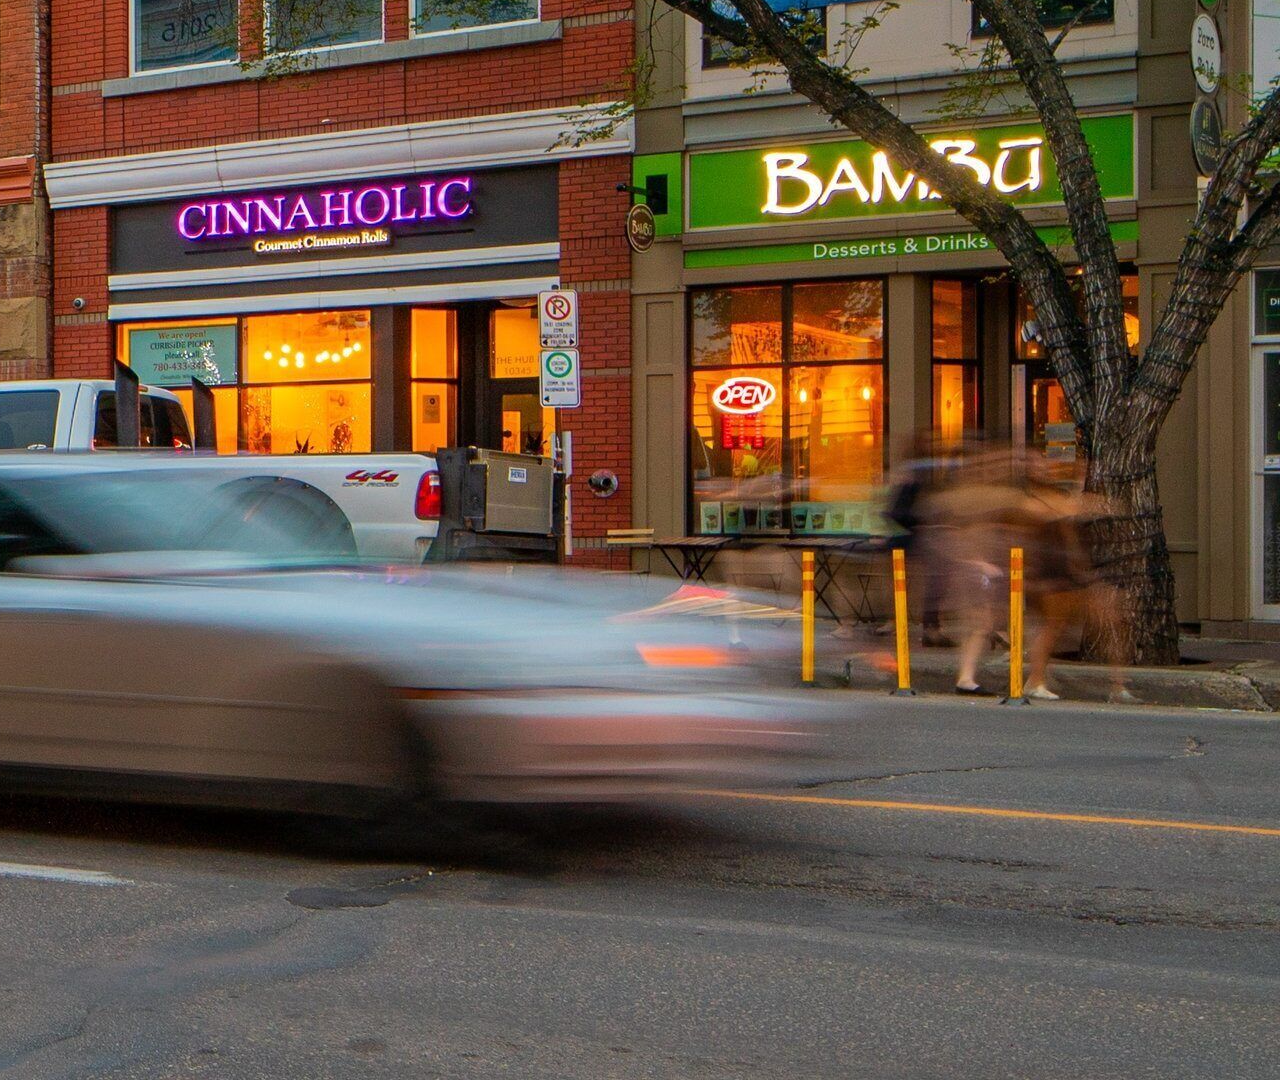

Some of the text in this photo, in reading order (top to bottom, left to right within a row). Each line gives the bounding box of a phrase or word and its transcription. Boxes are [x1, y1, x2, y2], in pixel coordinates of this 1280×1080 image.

[178, 178, 470, 239] CINNAHOLIC
[255, 230, 388, 253] Gourmet Cinnamon Rolls
[813, 234, 989, 259] Desserts & Drinks
[184, 330, 207, 340] open!
[165, 352, 188, 361] pleas
[717, 384, 769, 405] OPEN
